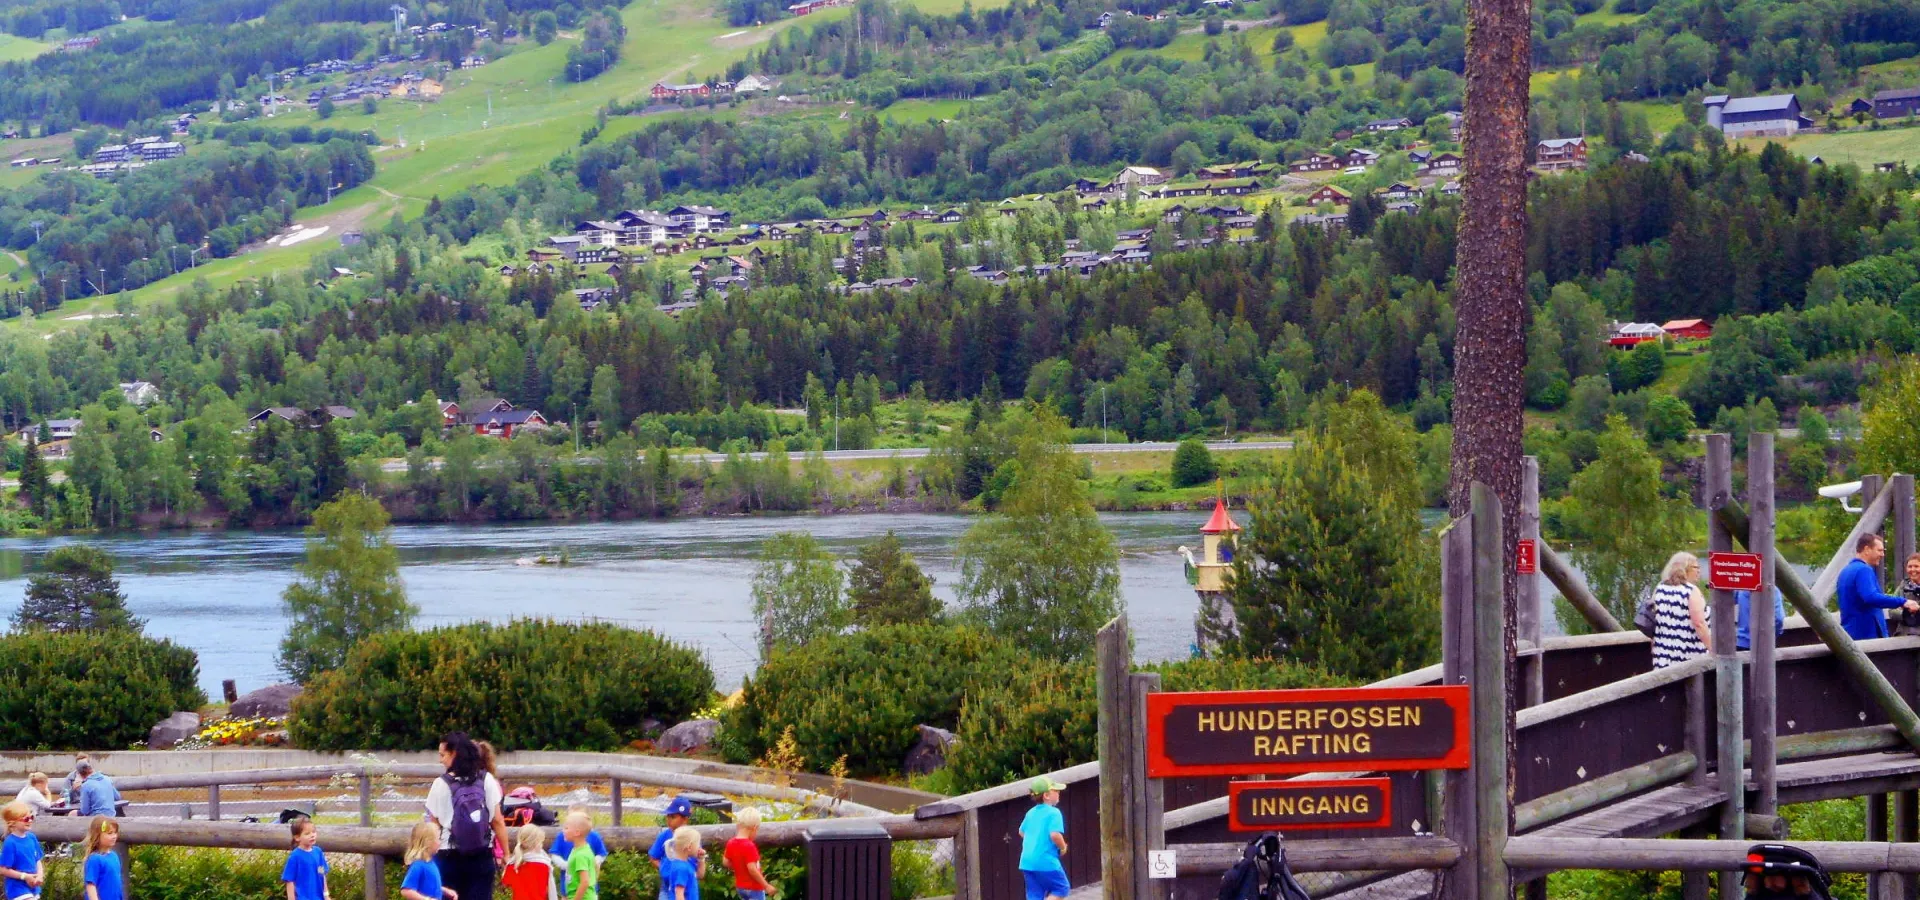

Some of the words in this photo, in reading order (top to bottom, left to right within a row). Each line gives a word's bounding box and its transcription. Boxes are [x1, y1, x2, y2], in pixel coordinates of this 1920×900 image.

[1198, 705, 1421, 732] HUNDERFOSSEN
[1254, 732, 1371, 756] RAFTING
[1252, 794, 1369, 816] INNGANG
